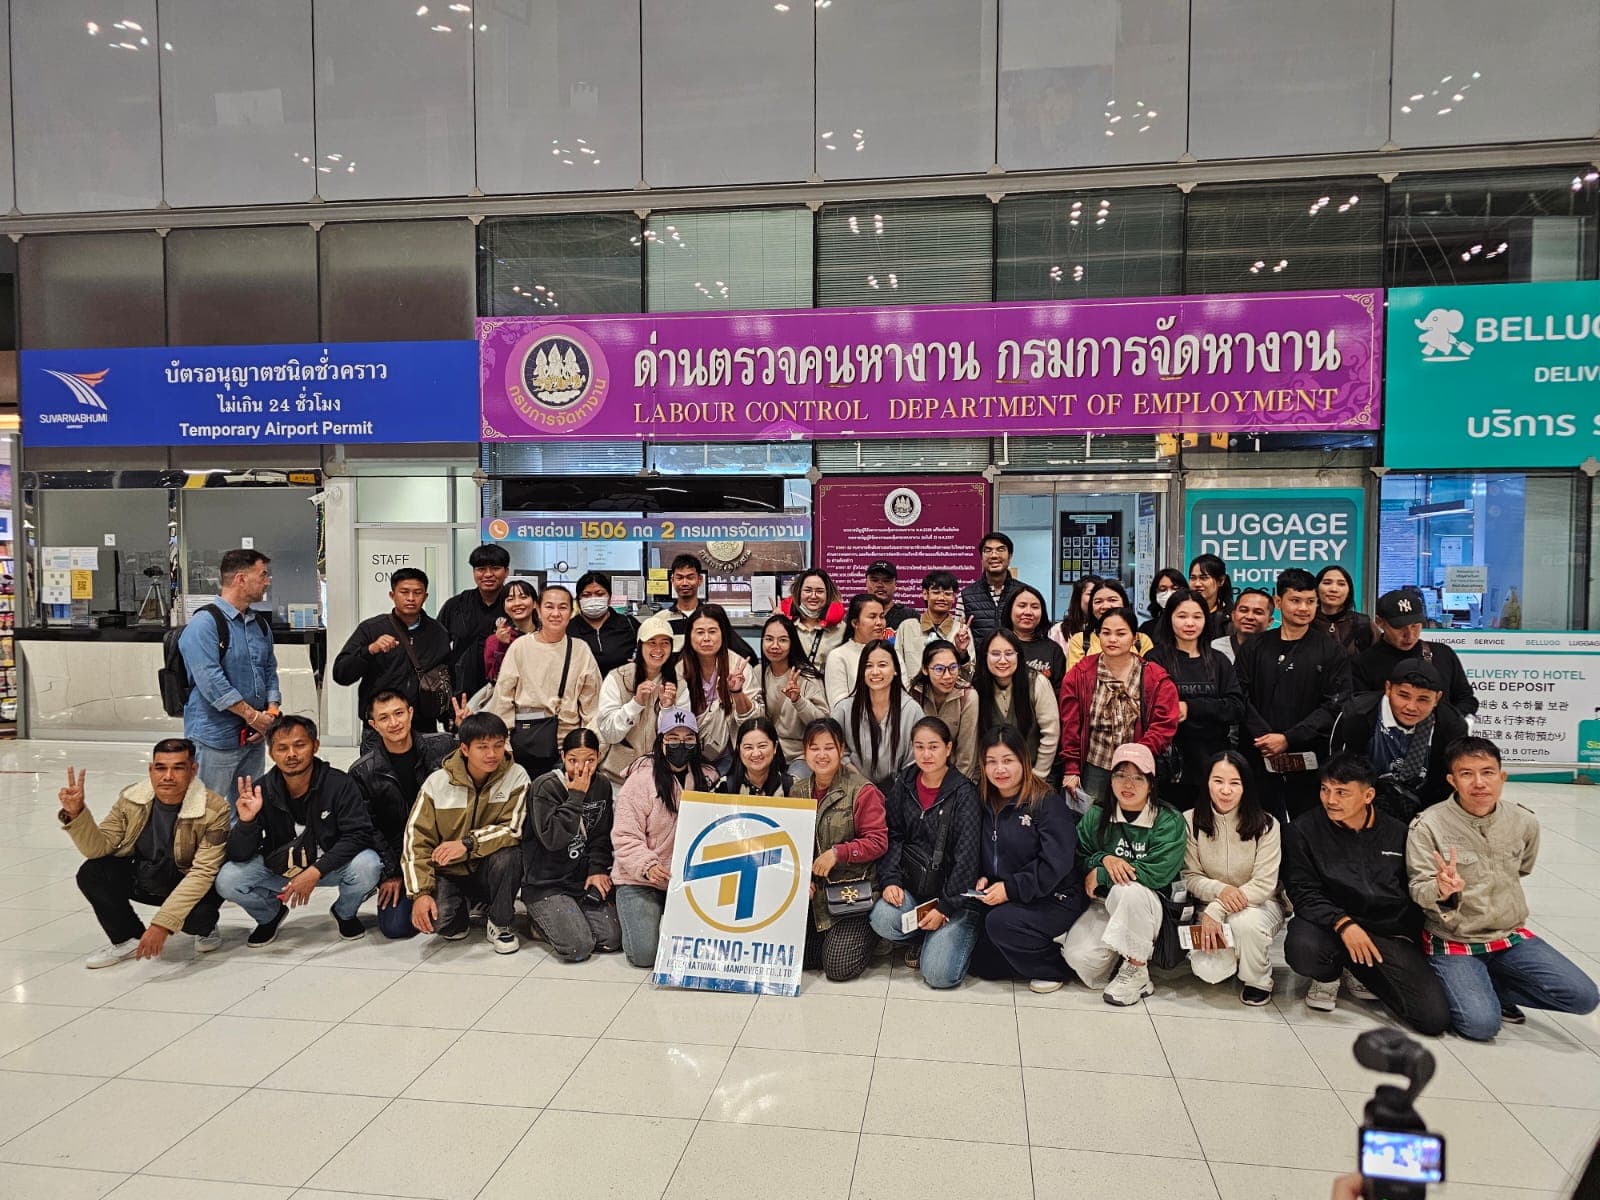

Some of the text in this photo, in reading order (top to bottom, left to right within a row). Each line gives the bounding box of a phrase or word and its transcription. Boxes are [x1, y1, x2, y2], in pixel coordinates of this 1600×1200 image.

[633, 315, 1342, 388] ด่านตรวจคนหางาน กรมการจัดหางาน
[165, 349, 388, 391] บัตรอนุญาตชนิดชั่วคราว
[1534, 366, 1600, 382] DELIV
[217, 387, 341, 413] ไม่เกิน 24 ชั่วโมง
[509, 378, 606, 426] กรมการจัดหางาน
[633, 388, 1339, 424] LABOUR CONTROL DEPARTMENT OF EMPLOYMENT
[39, 413, 108, 424] SUVARNABHUMI
[1467, 408, 1576, 438] บริการ
[179, 420, 373, 440] Temporary Airport Permit
[517, 520, 804, 540] สายด่วน 1506 กด 2 กรมการจัดหางาน
[1200, 512, 1348, 536] LUGGAGE
[372, 553, 410, 565] STAFF
[1200, 538, 1348, 561] DELIVERY
[374, 571, 393, 583] ON
[1465, 668, 1586, 680] ELIVERY TO HOTEL
[1471, 681, 1556, 692] AGE DEPOSIT
[1501, 700, 1509, 710] &
[1494, 716, 1502, 725] &
[1505, 731, 1512, 740] &
[671, 935, 795, 967] TECHNO-THAI
